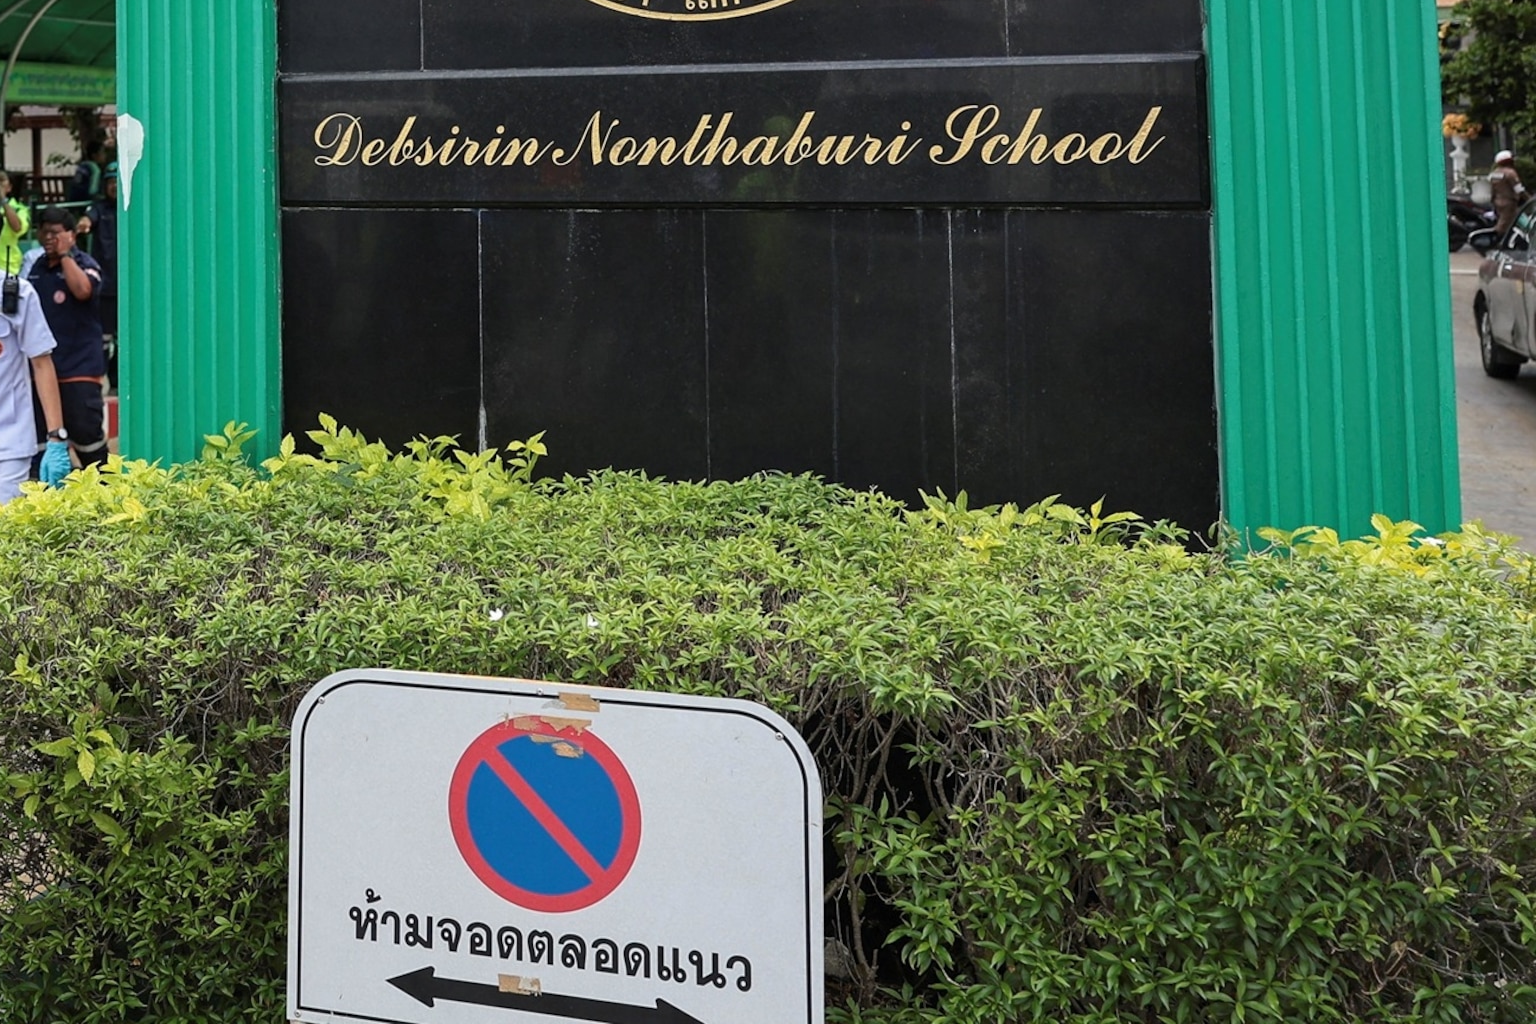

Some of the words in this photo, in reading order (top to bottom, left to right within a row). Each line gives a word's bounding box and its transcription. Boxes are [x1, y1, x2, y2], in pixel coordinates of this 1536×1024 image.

[314, 112, 554, 167] Debsirin
[551, 110, 922, 167] Nonthaburi
[929, 104, 1166, 165] School
[349, 888, 753, 993] ห้ามจอดตลอดแนว
